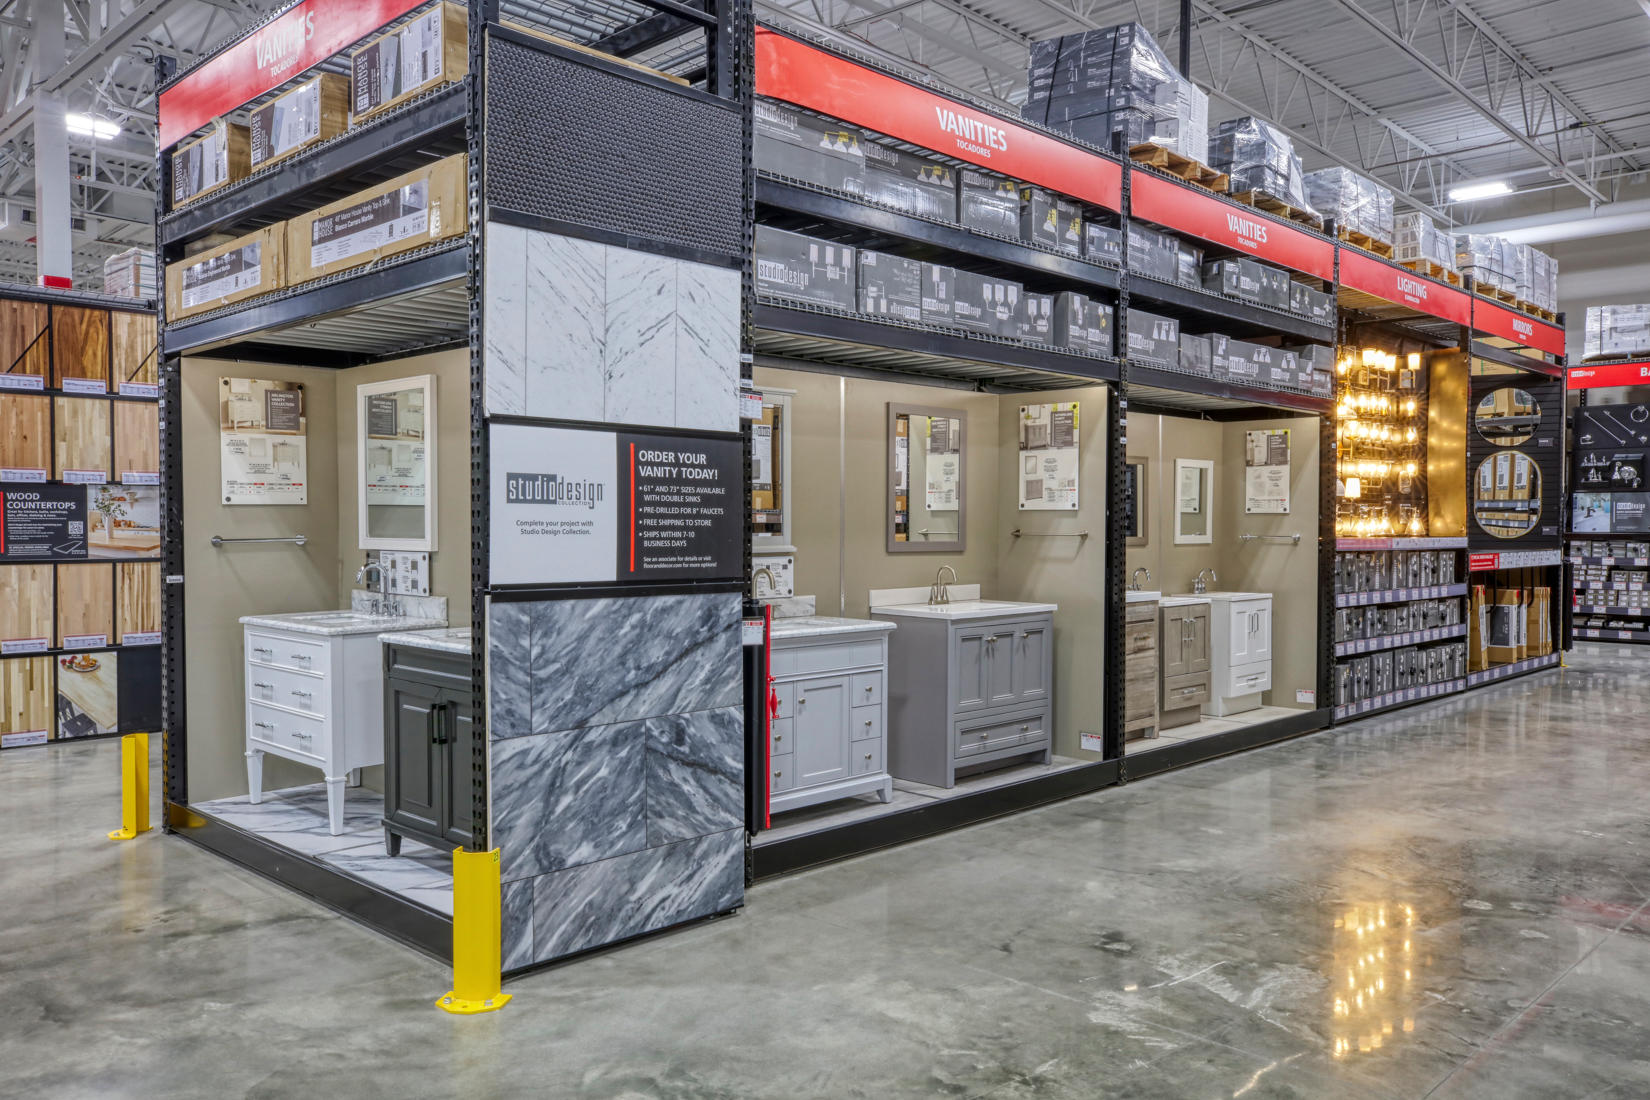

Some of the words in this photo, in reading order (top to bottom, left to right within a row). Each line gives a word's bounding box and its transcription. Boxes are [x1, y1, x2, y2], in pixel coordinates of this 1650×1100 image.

[256, 10, 314, 70] VANITIES
[935, 106, 1008, 151] VANITIES
[956, 138, 991, 158] TOCADORES
[1226, 213, 1268, 243] VANITIES
[758, 260, 809, 290] studiodesign
[1397, 275, 1427, 299] LIGHTING
[639, 450, 675, 463] ORDER
[678, 452, 707, 465] YOUR
[639, 465, 678, 478] VANITY
[681, 467, 718, 480] TODAY!
[6, 492, 40, 500] WOOD
[507, 473, 603, 509] studiodesign
[655, 485, 669, 493] AND
[681, 486, 695, 494] SIZES
[696, 487, 726, 495] AVAILABLE
[7, 501, 76, 509] COUNTERTOPS
[685, 495, 701, 503] SINKS
[516, 519, 544, 528] Complete
[560, 520, 580, 528] project
[541, 528, 560, 536] Design
